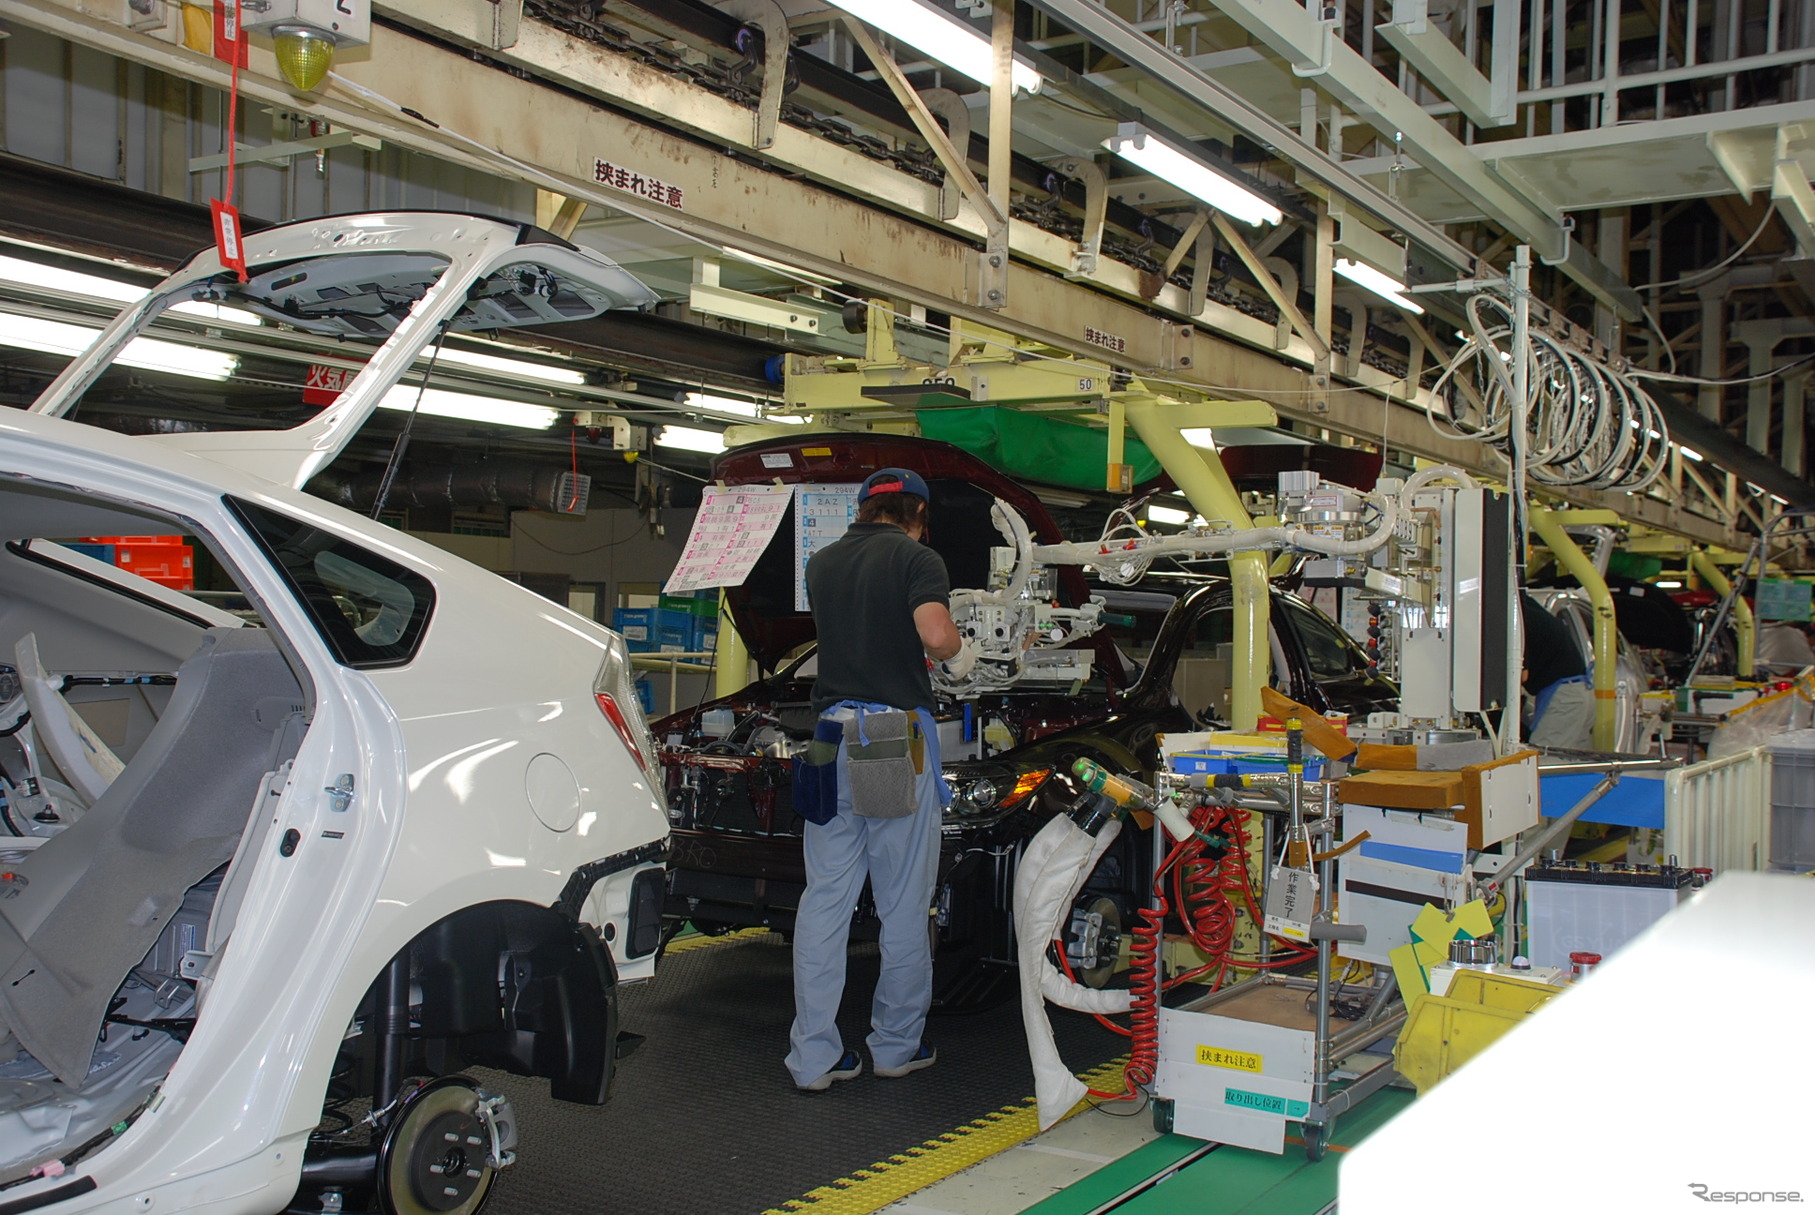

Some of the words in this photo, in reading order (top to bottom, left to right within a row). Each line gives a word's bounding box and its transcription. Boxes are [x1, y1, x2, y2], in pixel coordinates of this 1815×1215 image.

[595, 160, 682, 208] 挟まれ注意
[1086, 327, 1125, 352] 挟まれ注意
[1080, 379, 1092, 390] 50
[1284, 872, 1299, 918] 作業完了
[1201, 1049, 1257, 1069] 挟まれ注意
[1225, 1091, 1282, 1110] 取り出し位置
